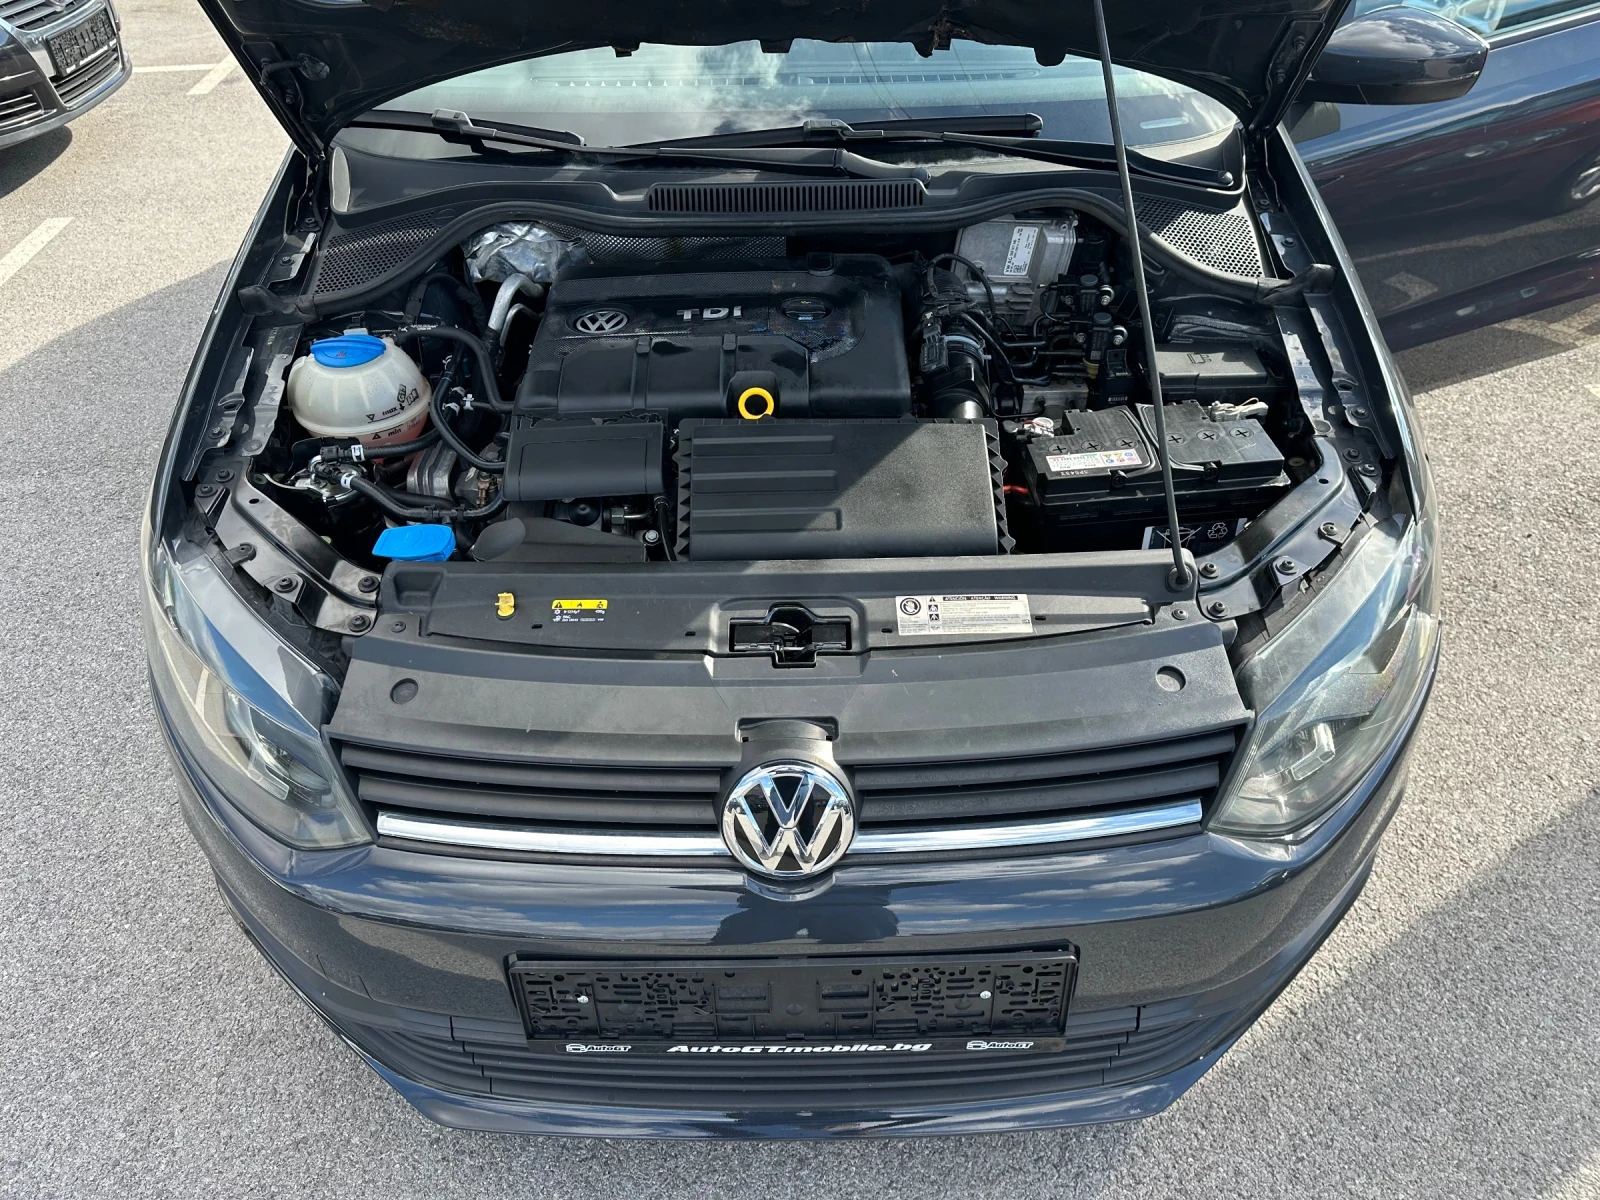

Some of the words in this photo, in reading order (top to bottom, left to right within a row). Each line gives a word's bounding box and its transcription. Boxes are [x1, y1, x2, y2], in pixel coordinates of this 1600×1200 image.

[677, 306, 742, 322] TDI
[382, 407, 398, 416] max
[387, 428, 402, 437] min
[722, 759, 854, 878] VW
[987, 1041, 1034, 1049] AutoGT
